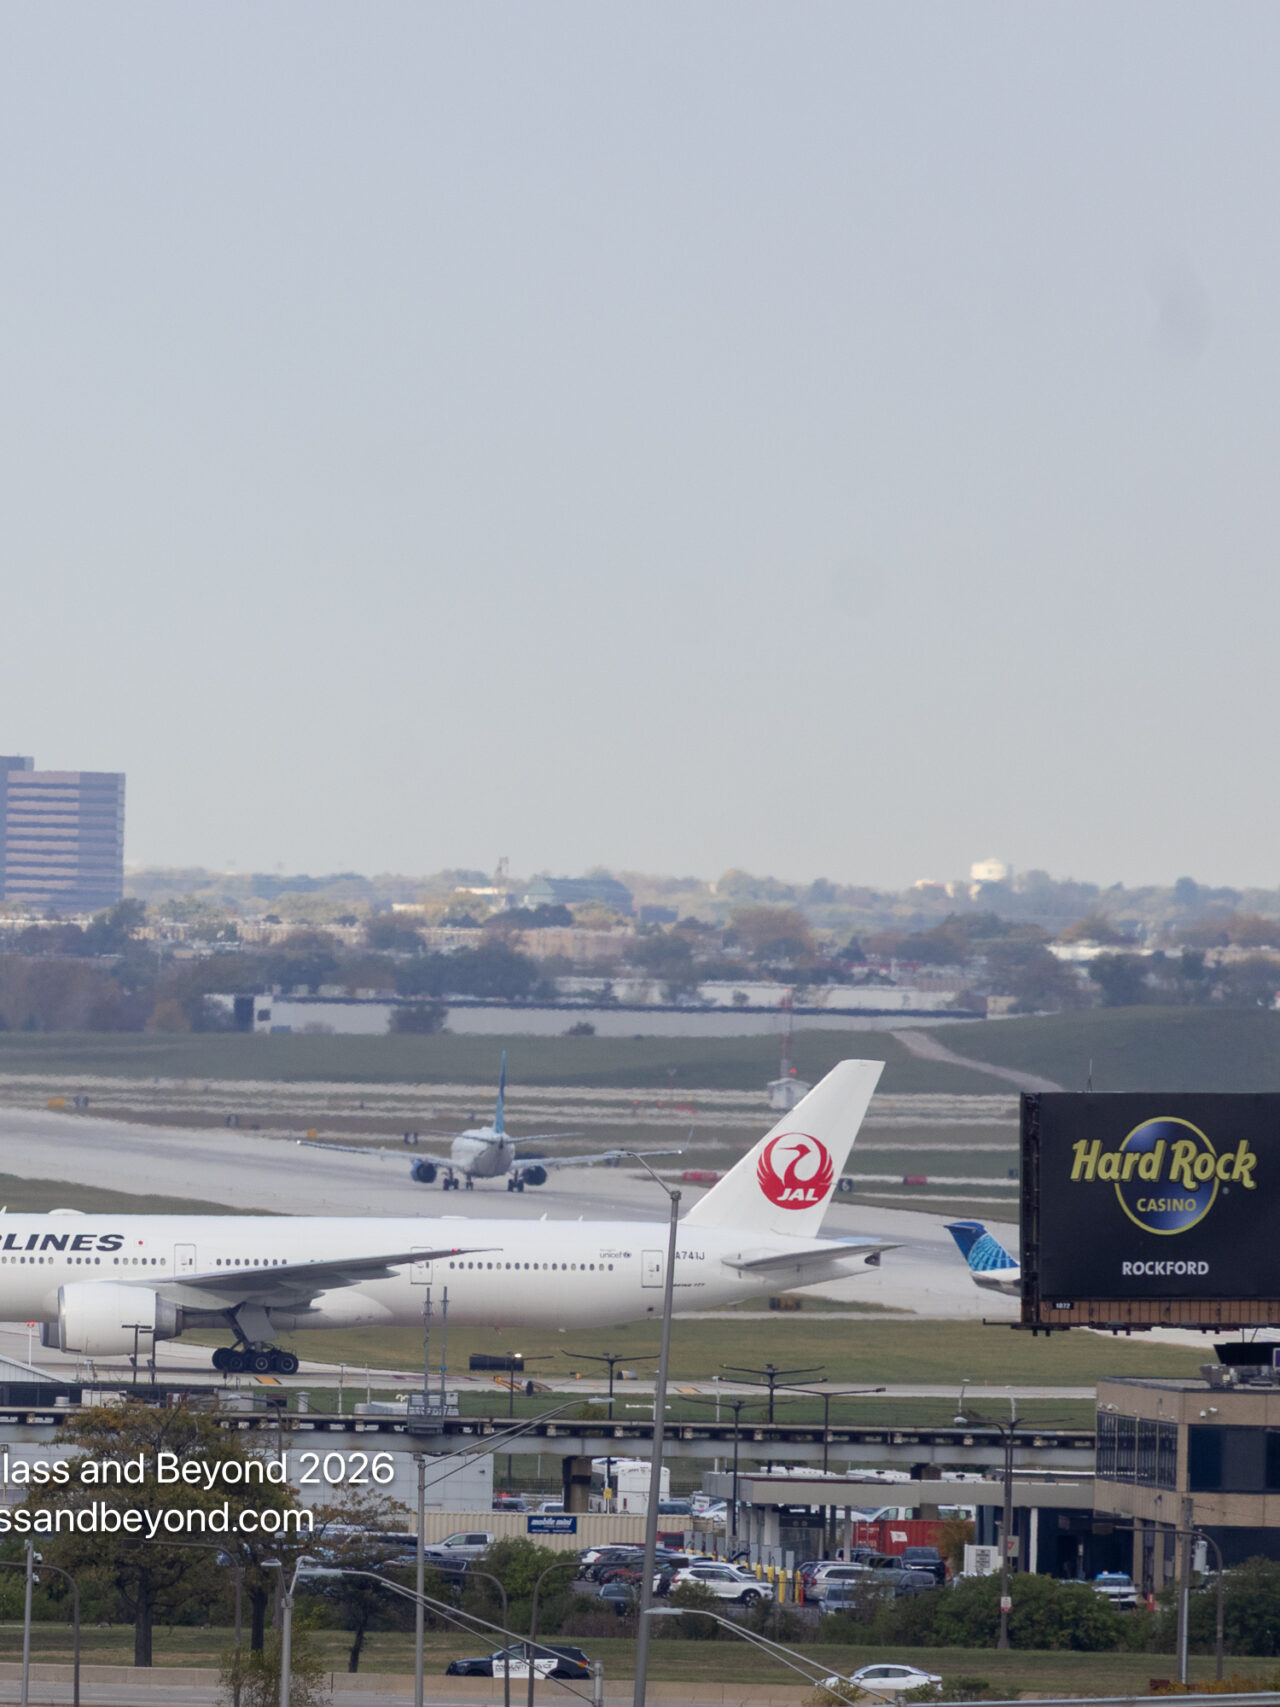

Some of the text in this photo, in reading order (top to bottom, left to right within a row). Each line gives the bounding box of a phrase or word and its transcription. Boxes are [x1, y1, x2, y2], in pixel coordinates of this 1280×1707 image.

[1070, 1139, 1257, 1190] Hard Rock
[776, 1187, 819, 1201] JAL
[1136, 1198, 1197, 1212] CASINO
[675, 1251, 705, 1261] A741J
[1121, 1261, 1210, 1276] ROCKFORD
